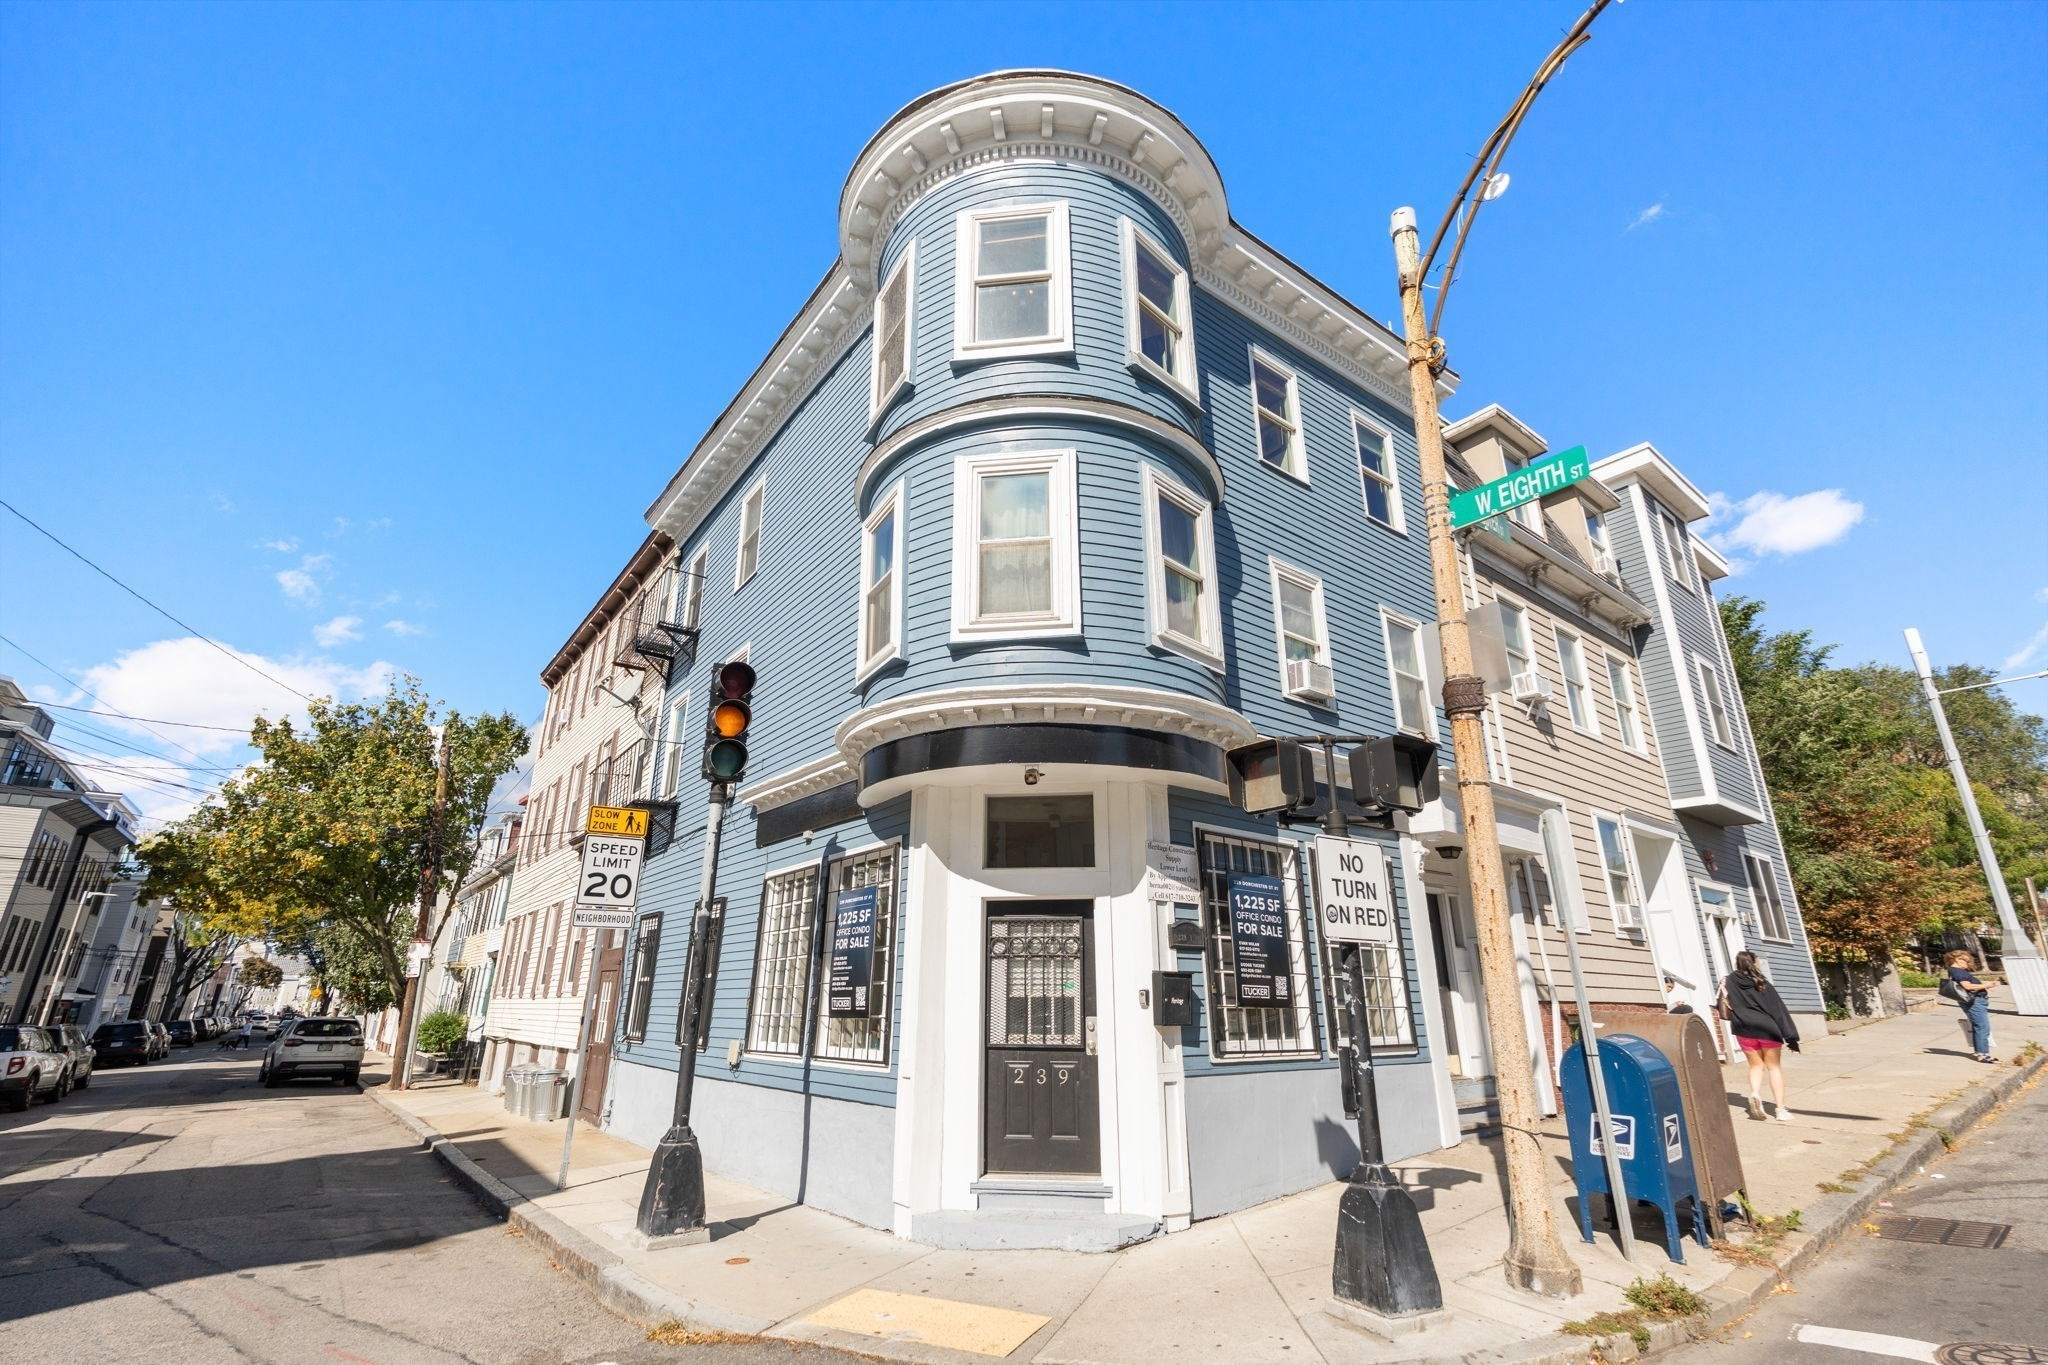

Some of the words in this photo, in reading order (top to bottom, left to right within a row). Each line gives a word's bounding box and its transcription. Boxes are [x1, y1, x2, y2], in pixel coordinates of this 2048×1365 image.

[1474, 489, 1492, 515] W
[1498, 460, 1566, 507] EIGHTH
[1570, 463, 1584, 479] ST
[594, 810, 620, 819] SLOW
[592, 821, 618, 831] ZONE
[590, 843, 638, 856] SPEED
[1147, 842, 1168, 854] Heritage
[1168, 845, 1197, 856] Construction
[593, 857, 631, 869] LIMIT
[1165, 855, 1182, 864] Supply
[1339, 853, 1364, 874] NO
[1160, 863, 1175, 871] Lower
[1176, 865, 1188, 873] Level
[583, 872, 632, 899] 20
[1156, 873, 1187, 882] Appointment
[1187, 876, 1198, 885] Only
[1331, 878, 1377, 900] TURN
[1235, 894, 1265, 910] 1,225
[1268, 898, 1280, 912] SF
[576, 913, 631, 924] NEIGHBORHOOD
[838, 910, 858, 926] 1,225
[859, 909, 871, 923] SF
[1236, 911, 1259, 921] OFFICE
[1260, 914, 1282, 923] CONDO
[1326, 904, 1352, 925] ON
[1354, 906, 1387, 927] RED
[836, 926, 851, 937] OFFICE
[851, 925, 871, 935] CONDO
[1237, 922, 1258, 935] FOR
[1260, 924, 1283, 938] SALE
[835, 938, 848, 950] FOR
[849, 936, 869, 949] SALE
[1243, 986, 1268, 996] TUCKER
[833, 999, 850, 1008] TUCKER
[1014, 1068, 1069, 1085] 239
